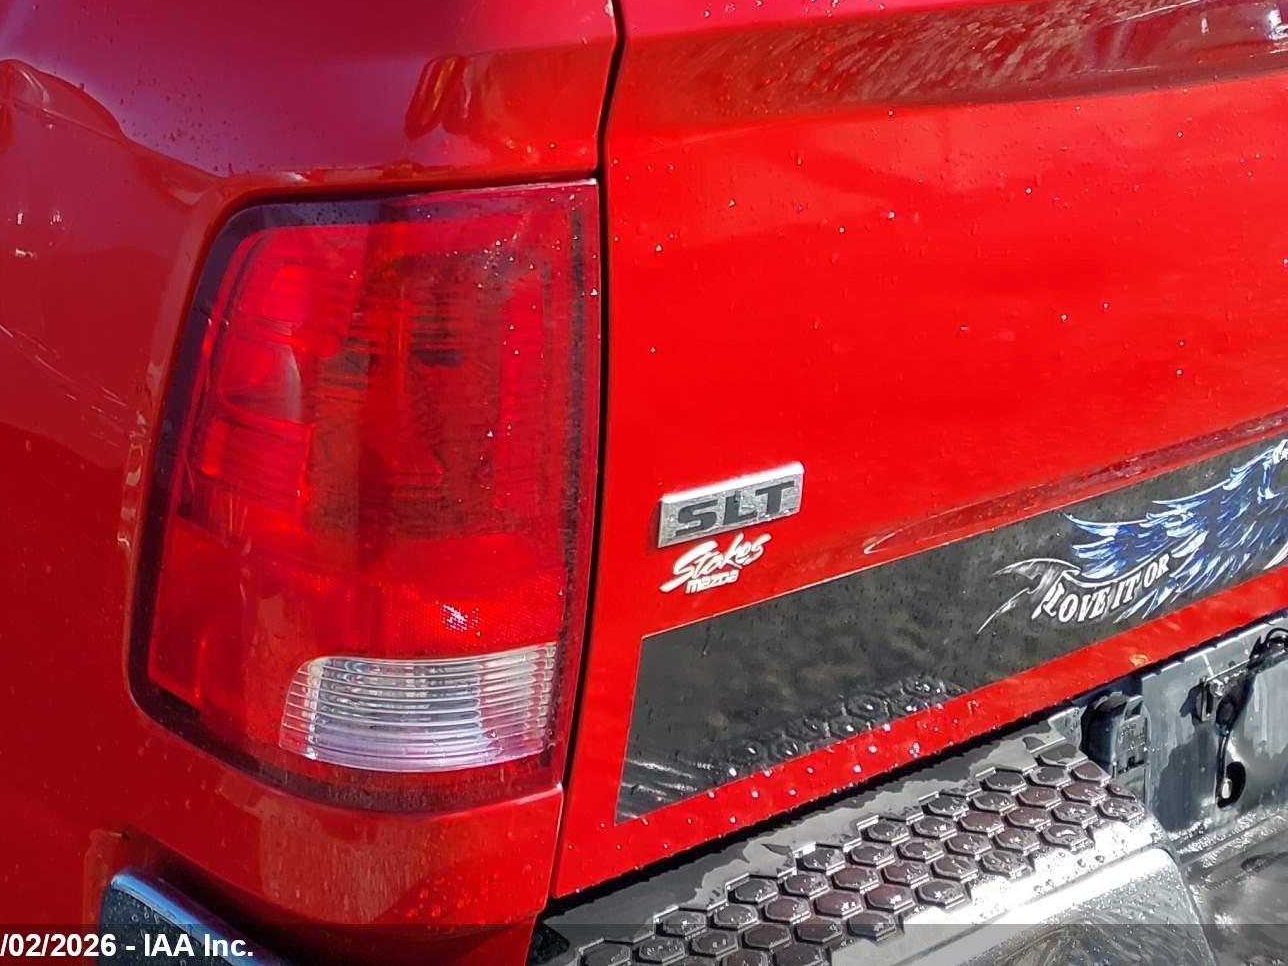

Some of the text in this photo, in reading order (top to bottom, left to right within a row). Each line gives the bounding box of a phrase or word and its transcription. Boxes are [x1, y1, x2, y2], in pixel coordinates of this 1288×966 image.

[675, 480, 795, 537] SLT
[1040, 553, 1170, 623] LOVE IT OR
